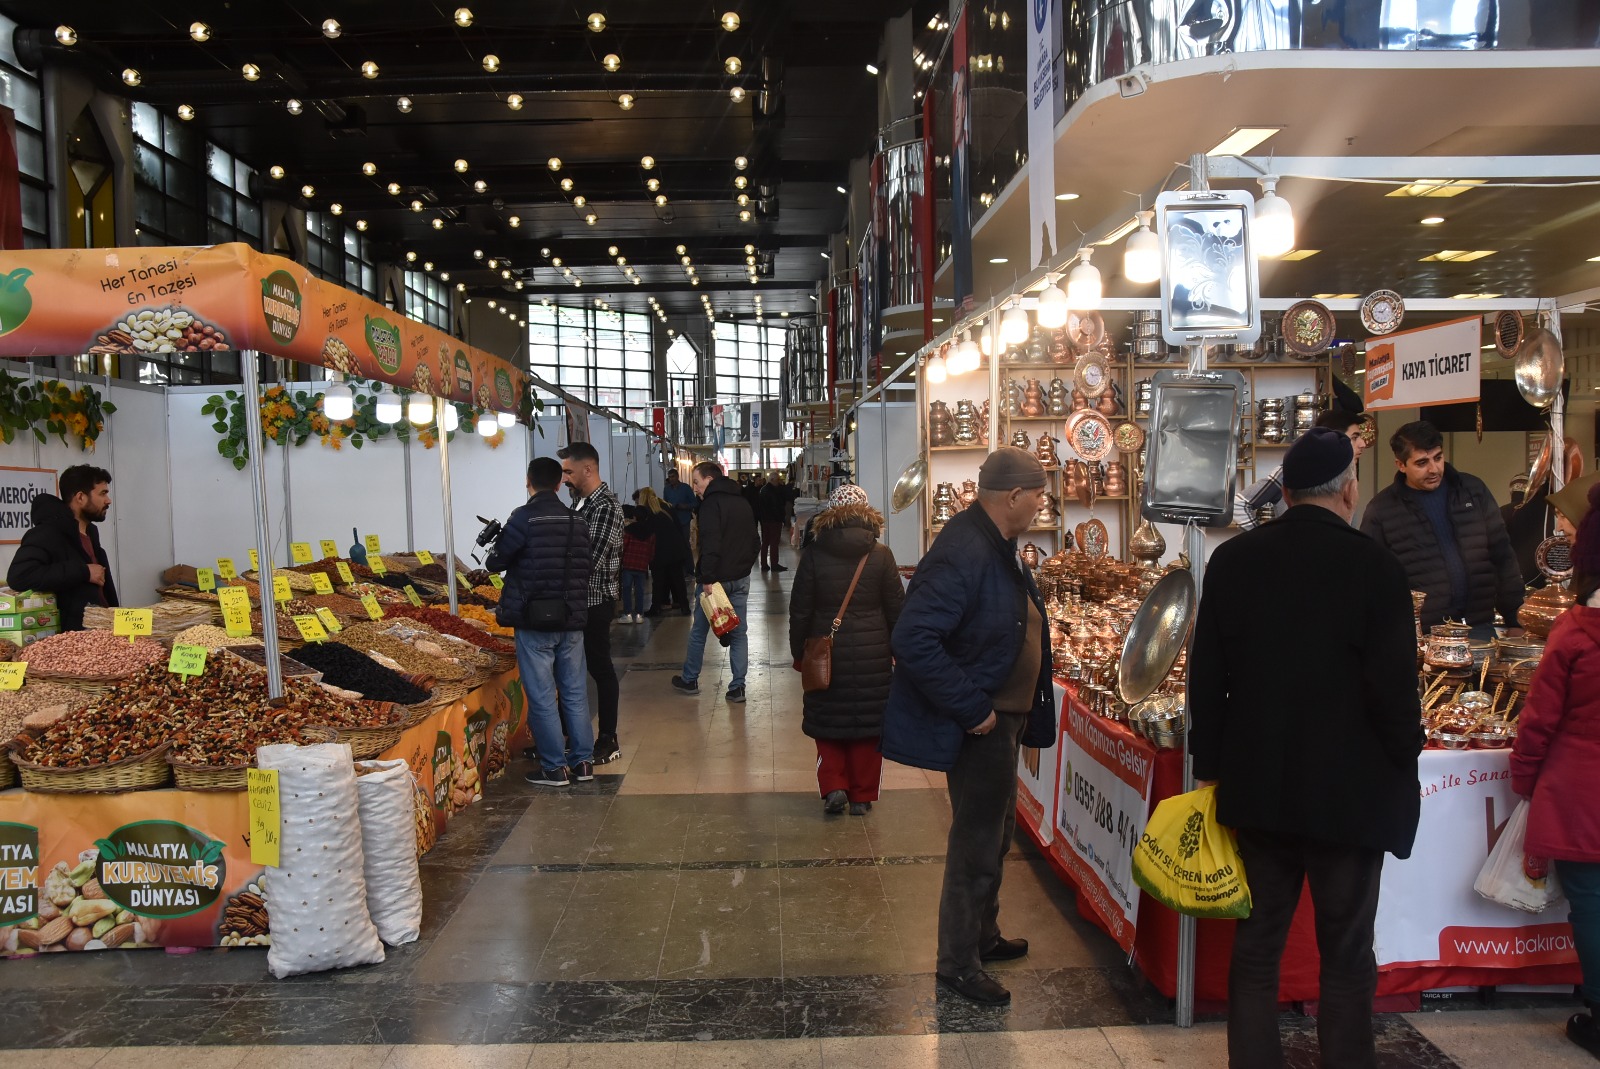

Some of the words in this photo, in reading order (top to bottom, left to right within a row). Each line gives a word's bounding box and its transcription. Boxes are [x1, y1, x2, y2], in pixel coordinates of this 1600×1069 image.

[100, 275, 126, 292] Her
[128, 256, 178, 282] Tanesi
[147, 272, 198, 299] Tazesi
[272, 284, 295, 303] MALATYA
[272, 318, 293, 339] DÜNYASI
[1402, 360, 1426, 381] KAYA
[1428, 353, 1471, 377] TİCARET
[1441, 773, 1461, 790] ile
[1466, 768, 1513, 786] Sana
[1074, 771, 1095, 816] 0555
[1094, 791, 1114, 834] 888
[0, 843, 33, 861] TYA
[125, 842, 189, 860] MALATYA
[1141, 832, 1165, 860] OĞAYI
[1205, 864, 1234, 884] KORU
[102, 860, 219, 890] KURUYEMİŞ
[0, 894, 33, 915] ASI
[131, 884, 200, 907] DÜNYASI
